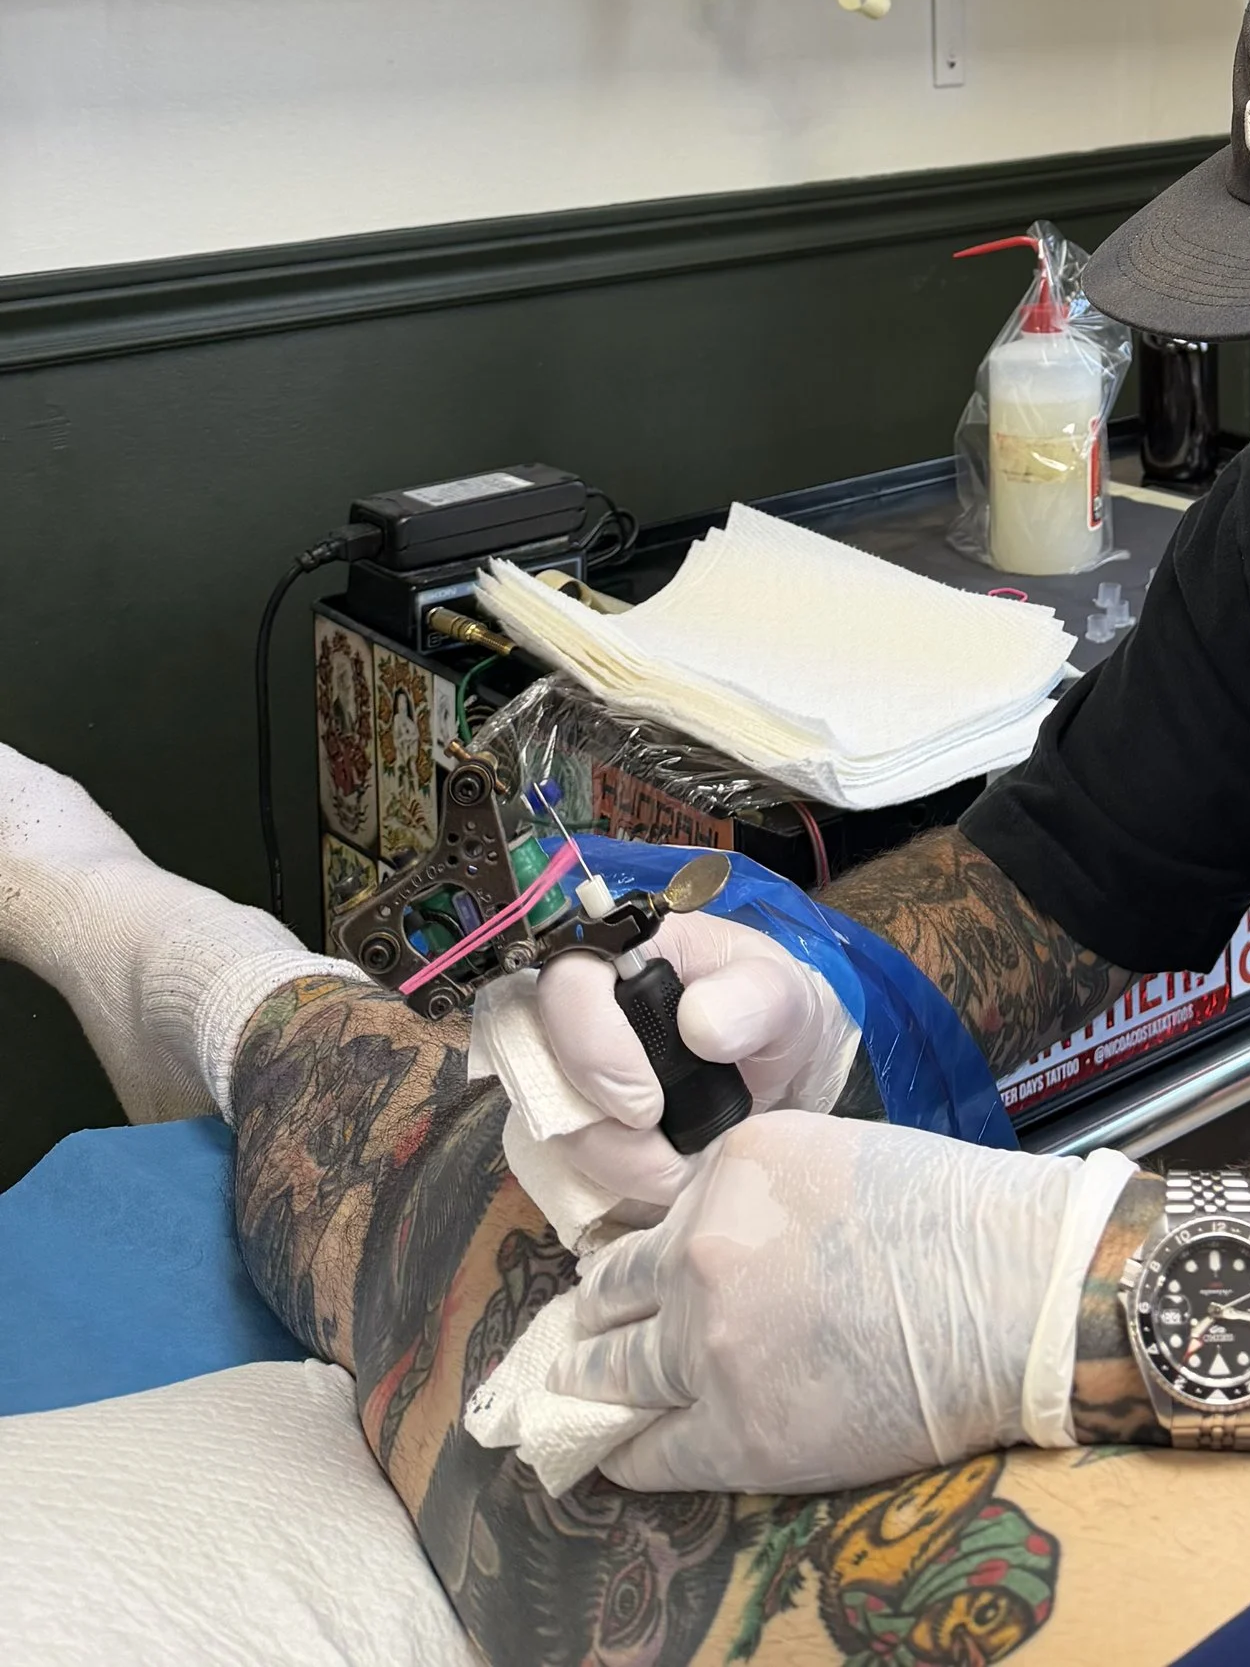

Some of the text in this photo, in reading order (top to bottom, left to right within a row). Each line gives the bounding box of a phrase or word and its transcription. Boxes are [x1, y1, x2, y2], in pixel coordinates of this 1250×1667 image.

[1019, 1074, 1044, 1101] DAYS
[1046, 1059, 1080, 1085] TATTOO
[1211, 1222, 1227, 1232] 12
[1174, 1230, 1191, 1244] 10
